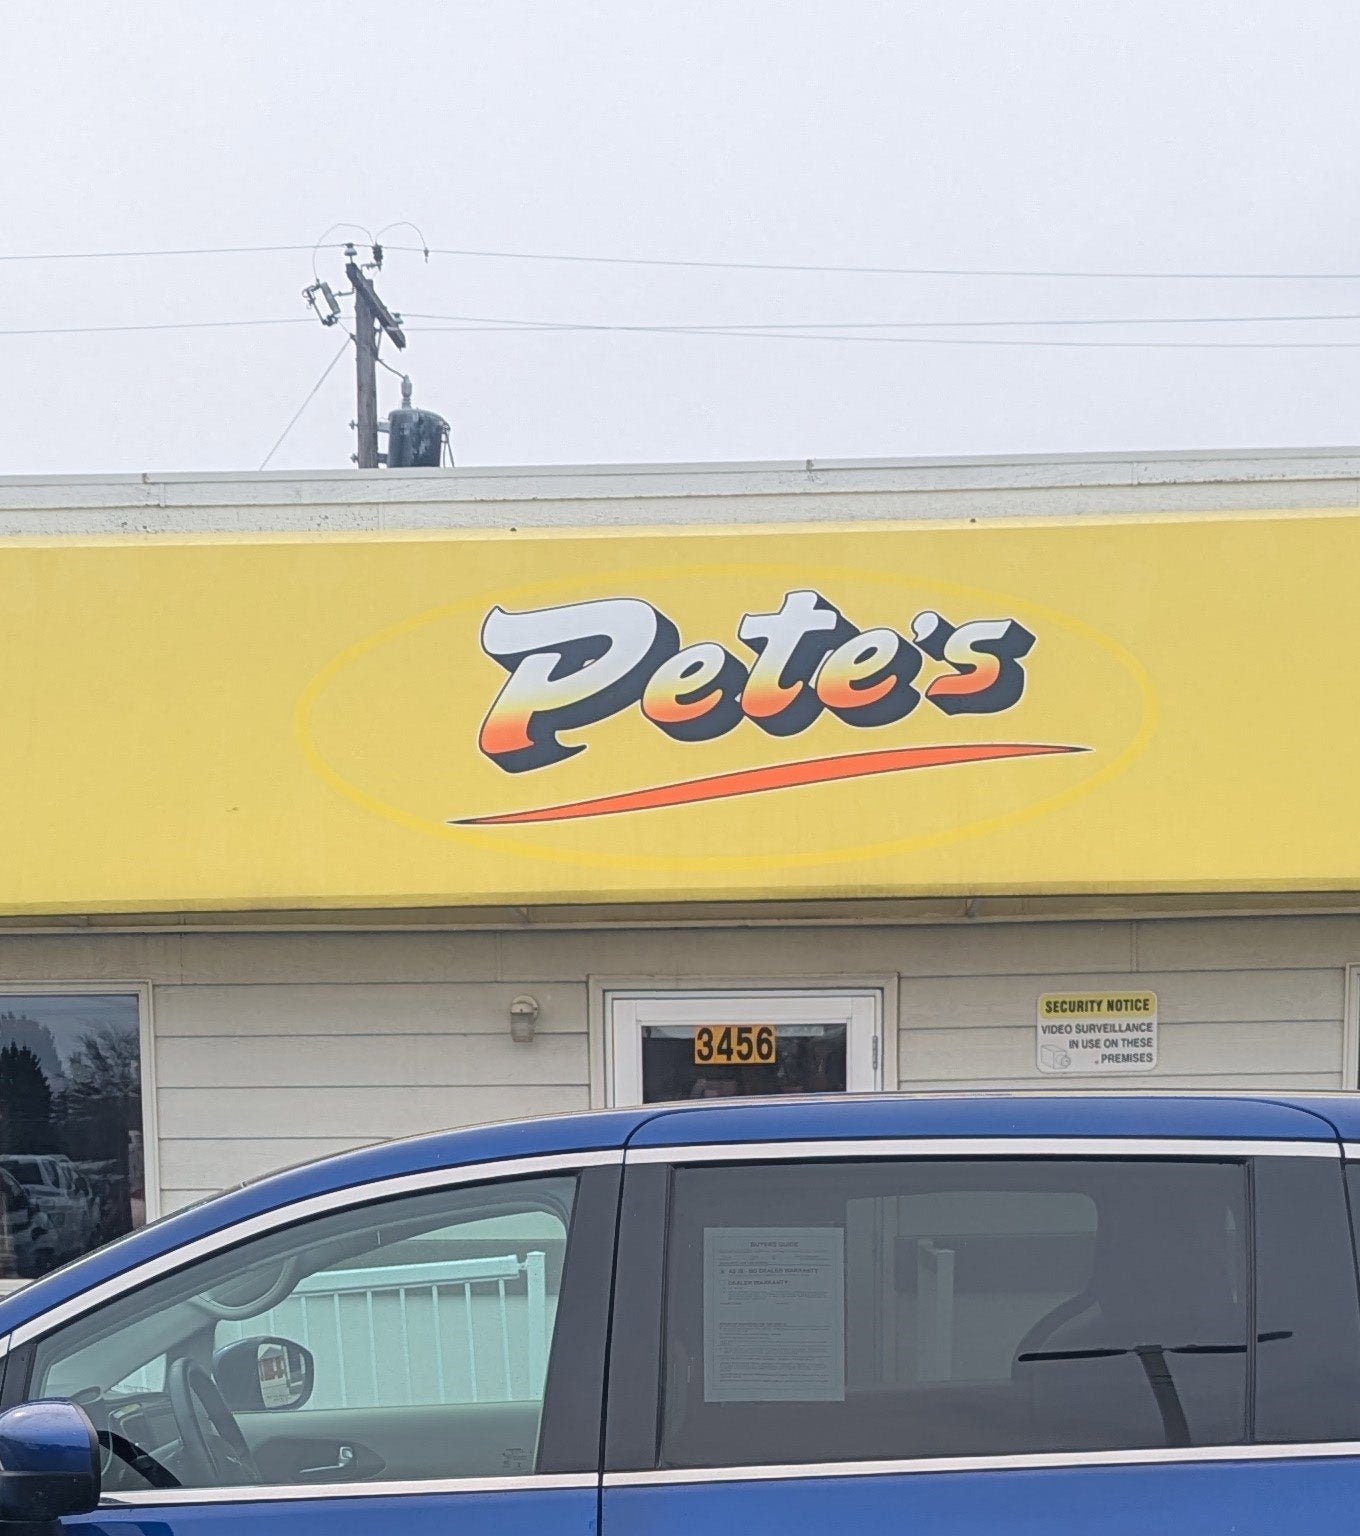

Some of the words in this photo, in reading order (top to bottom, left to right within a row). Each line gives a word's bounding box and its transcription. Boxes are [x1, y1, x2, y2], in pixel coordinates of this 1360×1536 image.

[478, 589, 1037, 775] Pete's
[1045, 999, 1103, 1013] SECURITY
[1107, 998, 1150, 1011] NOTICE
[1041, 1023, 1072, 1034] VIDEO
[1075, 1022, 1153, 1034] SURVEILLANCE
[697, 1026, 773, 1061] 3456
[1069, 1039, 1079, 1049] IN
[1081, 1039, 1100, 1049] USE
[1103, 1038, 1118, 1048] ON
[1121, 1037, 1153, 1048] THESE
[1101, 1052, 1153, 1063] PREMISES
